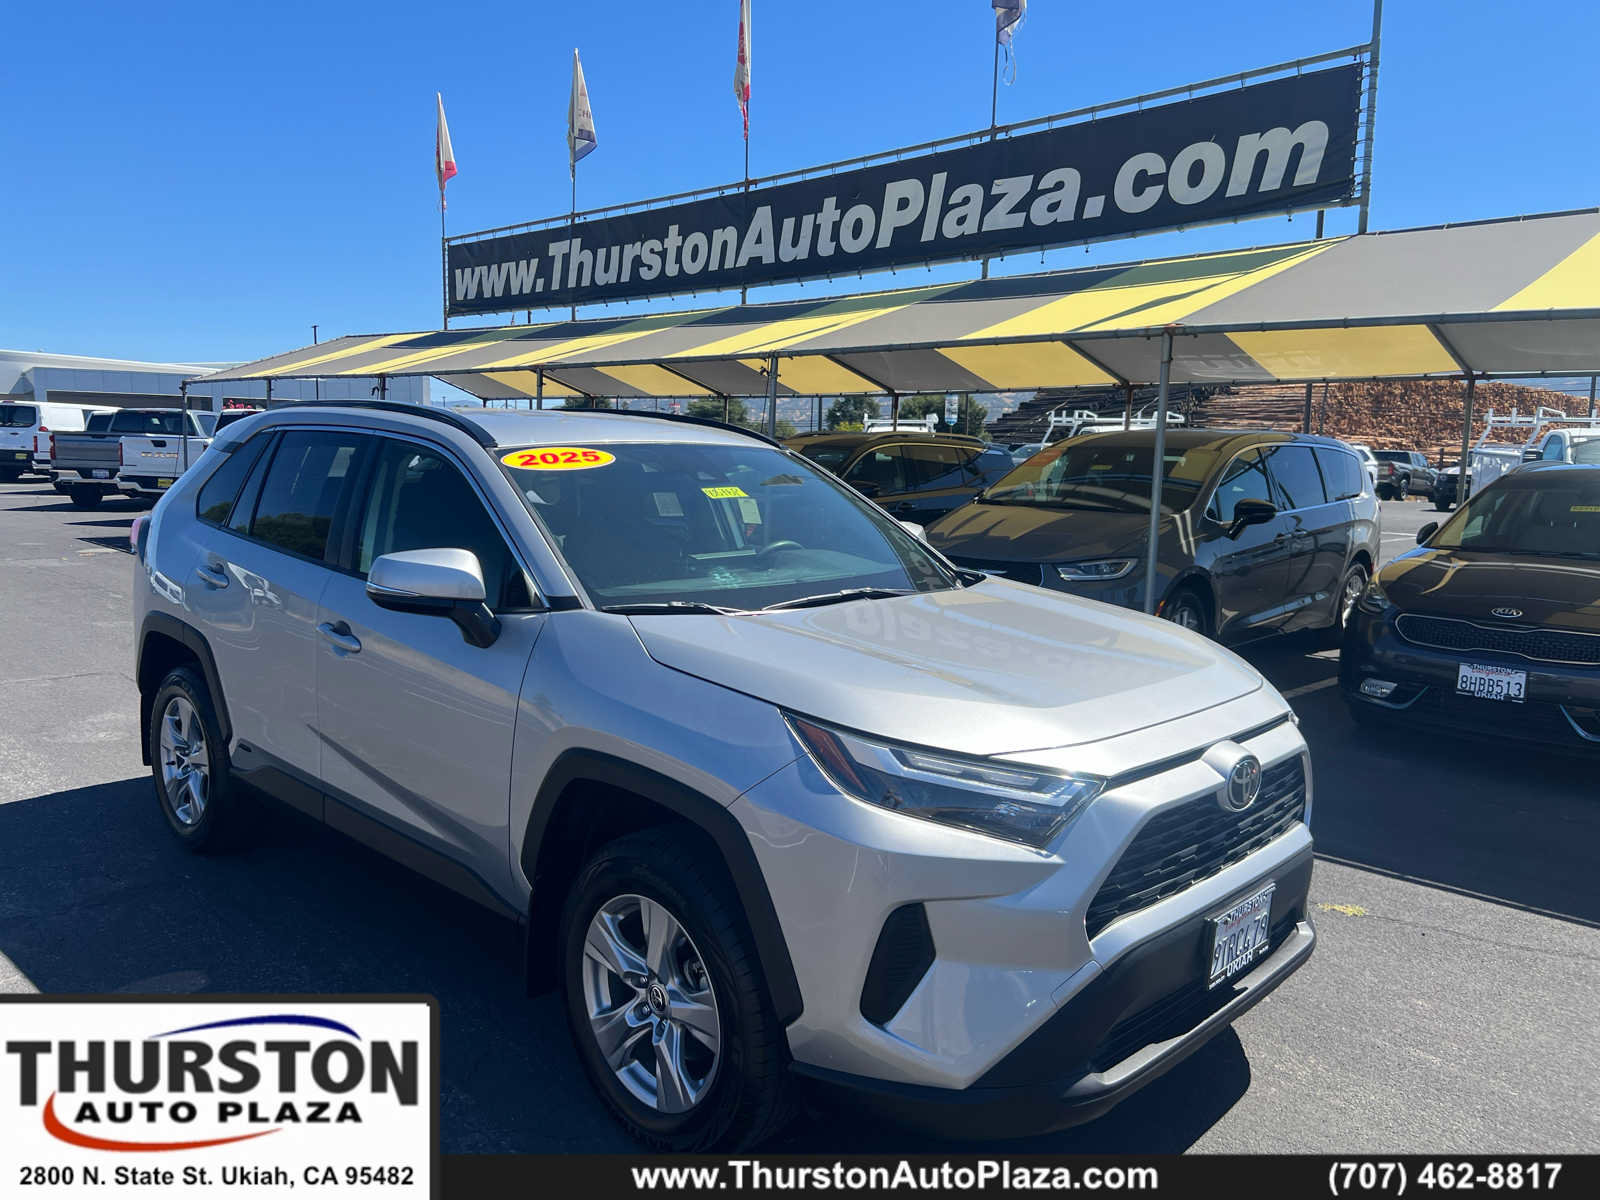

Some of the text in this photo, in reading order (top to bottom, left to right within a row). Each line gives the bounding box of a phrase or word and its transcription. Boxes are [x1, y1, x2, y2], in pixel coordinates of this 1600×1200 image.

[454, 120, 1329, 301] www.ThurstonAutoPlaza.com
[518, 451, 600, 466] 2025
[1460, 675, 1522, 697] 8HBB513
